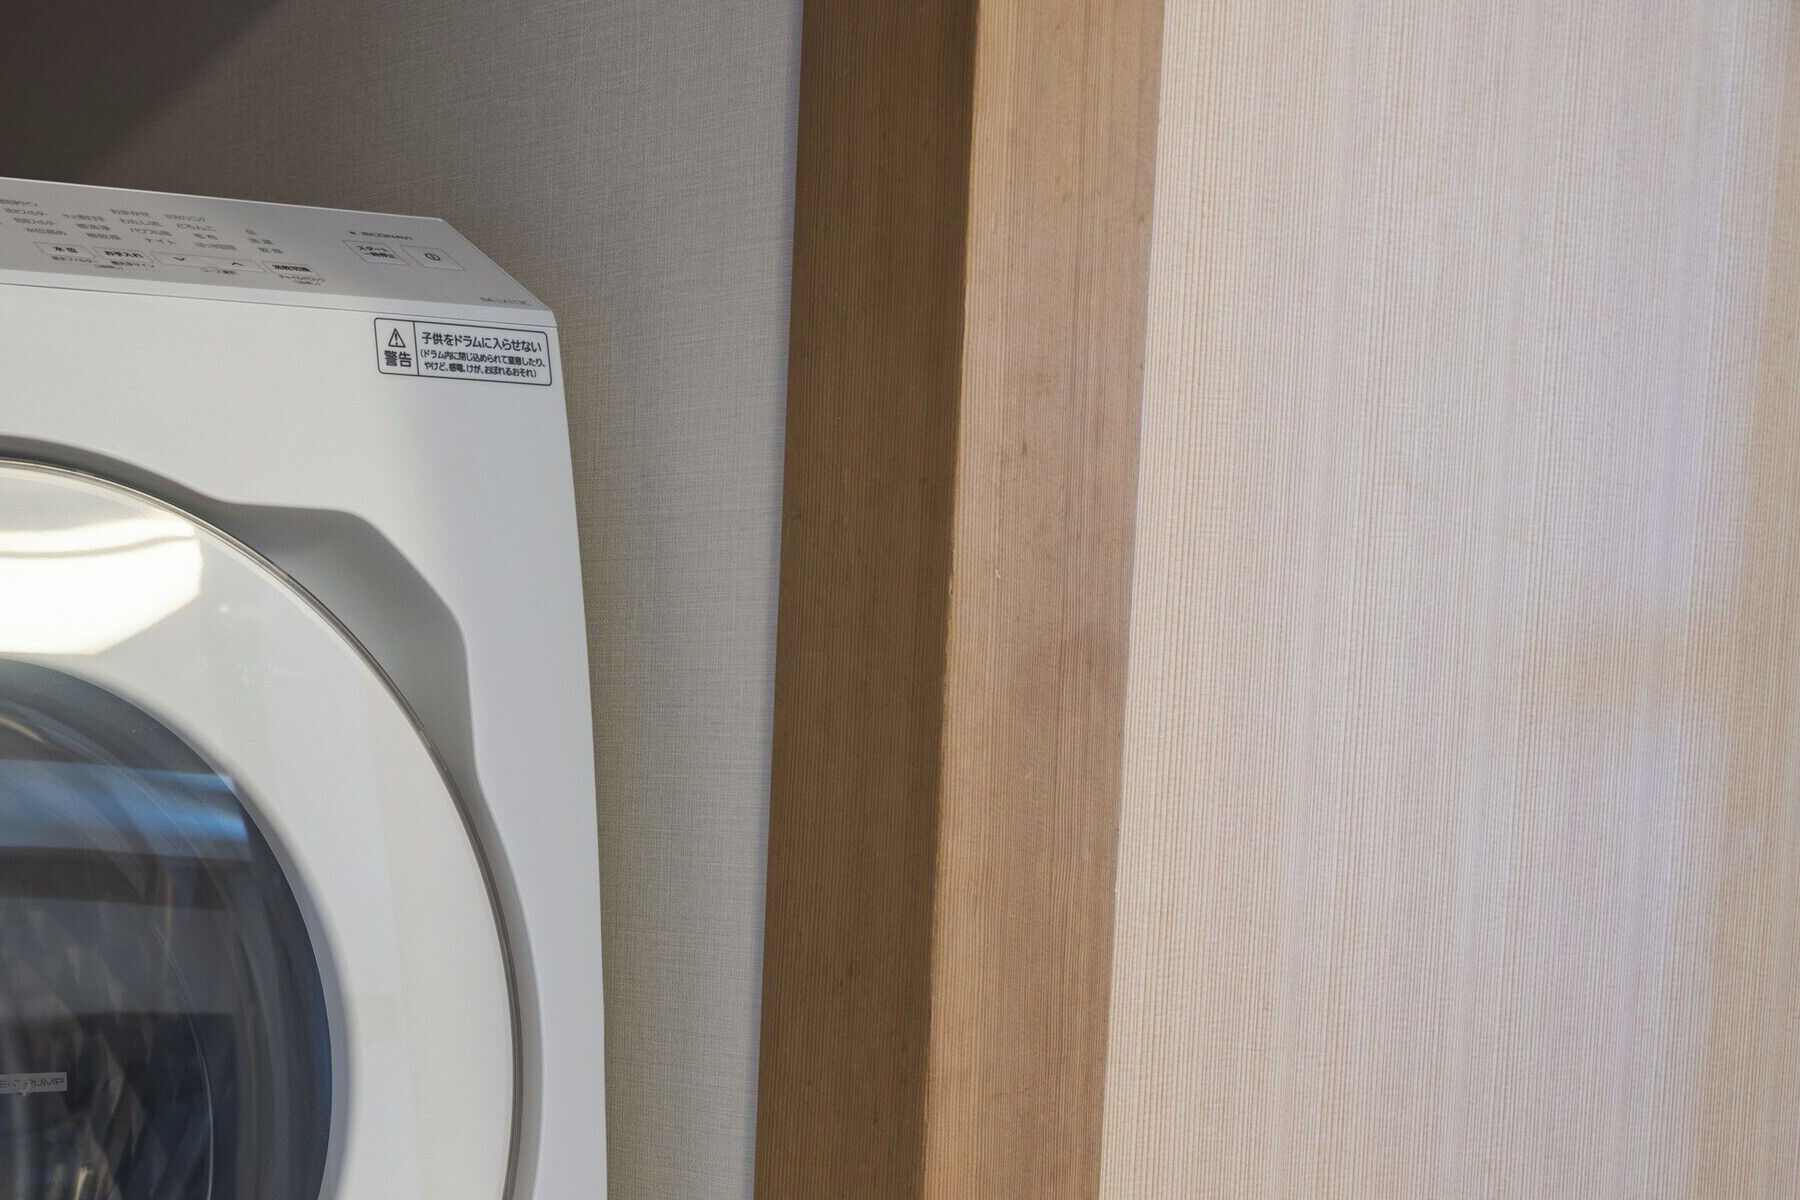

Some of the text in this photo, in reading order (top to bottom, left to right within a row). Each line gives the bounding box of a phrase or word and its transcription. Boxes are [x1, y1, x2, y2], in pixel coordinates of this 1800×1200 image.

[421, 331, 542, 353] 子供をドラムに入らせない
[384, 350, 412, 368] 警告
